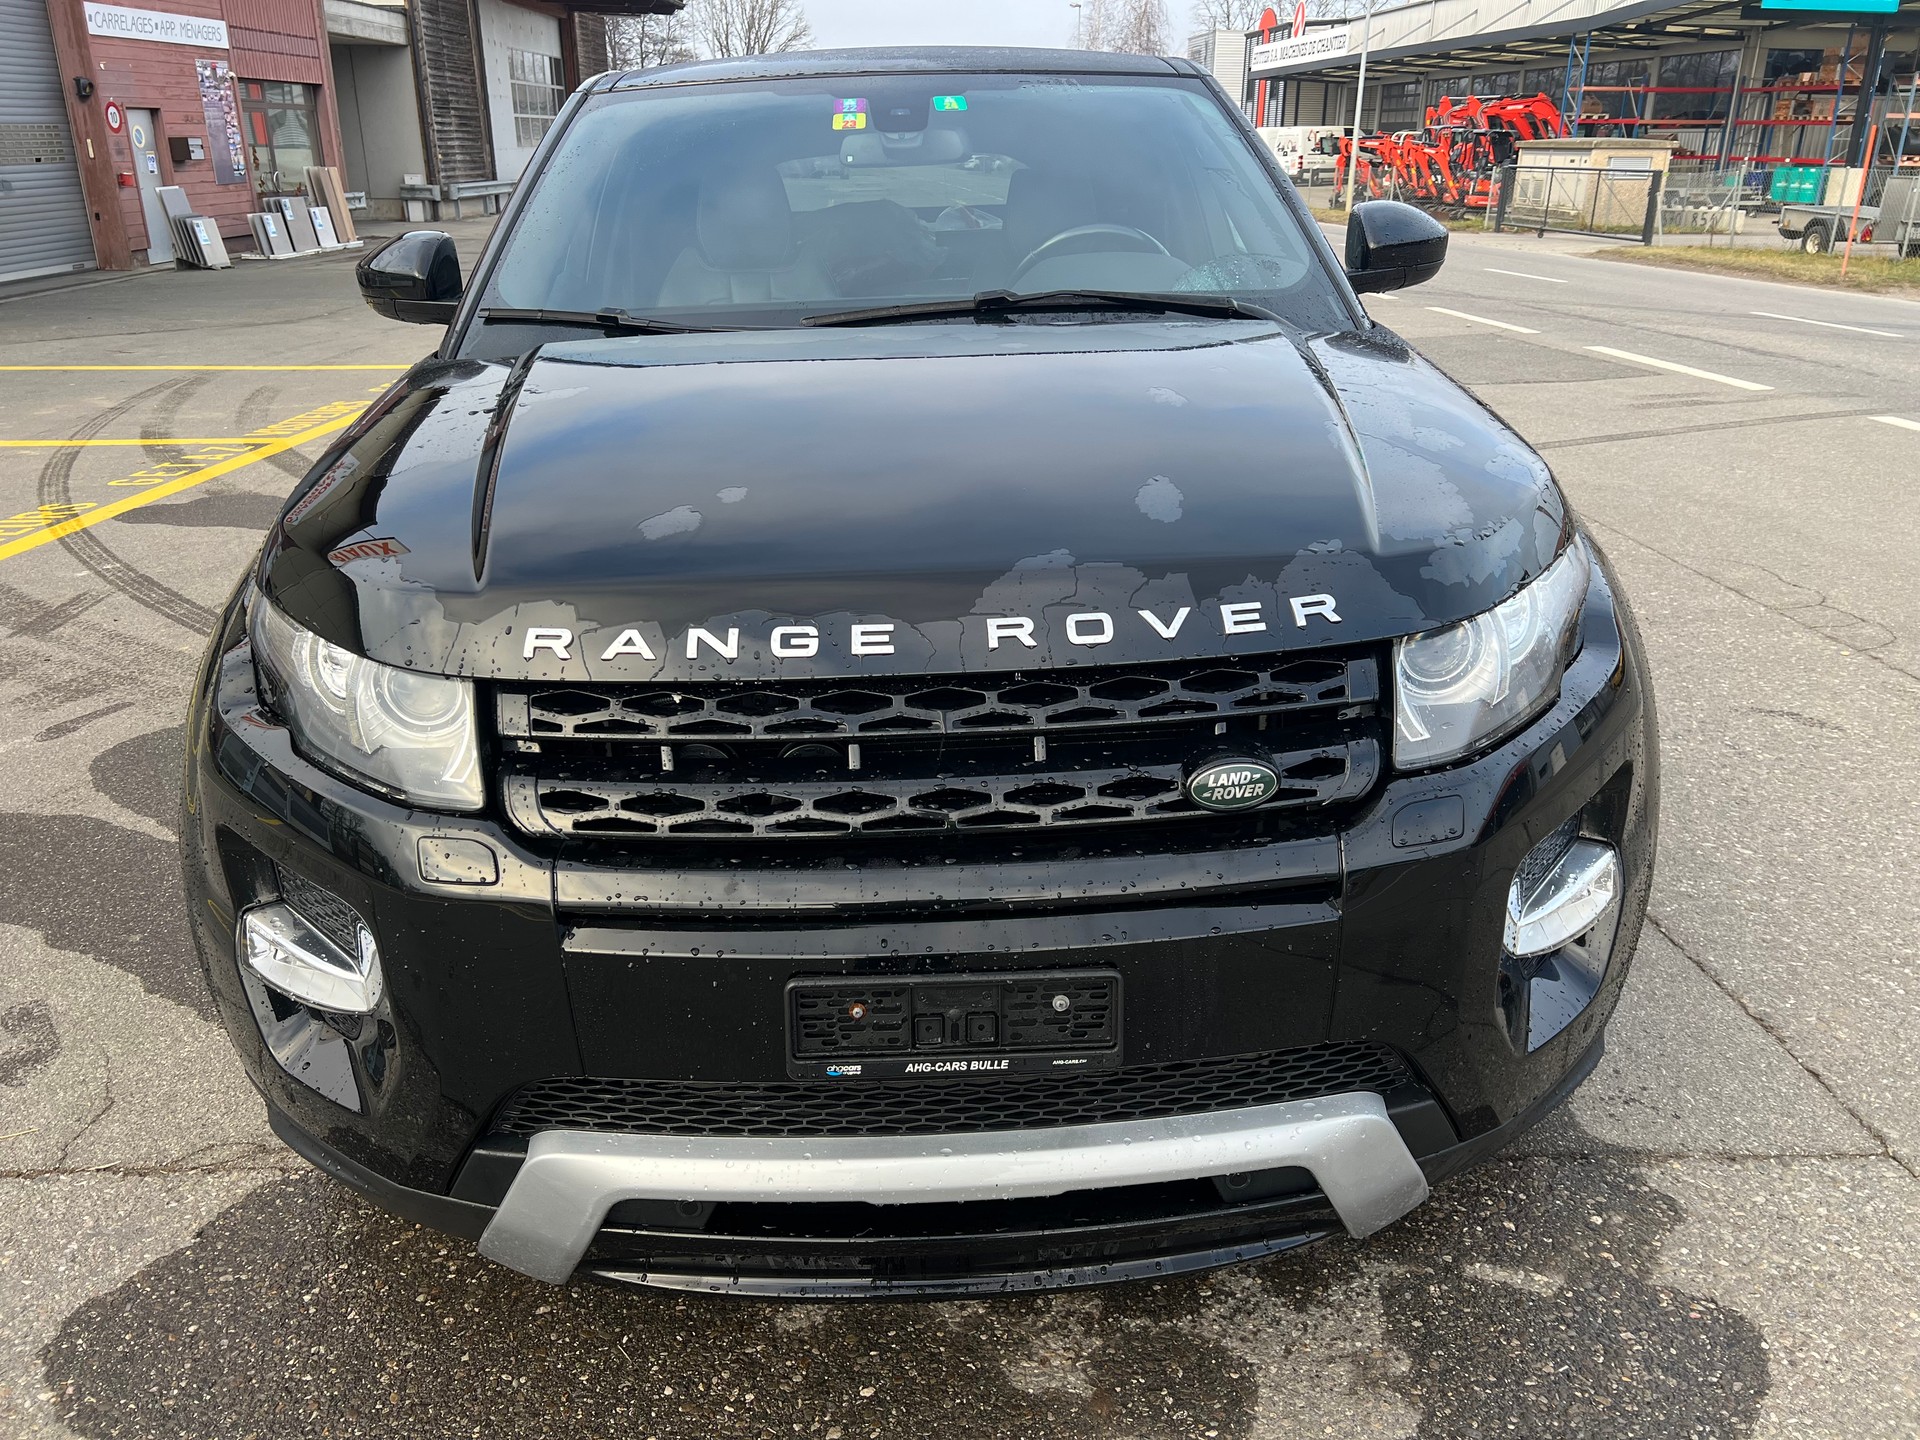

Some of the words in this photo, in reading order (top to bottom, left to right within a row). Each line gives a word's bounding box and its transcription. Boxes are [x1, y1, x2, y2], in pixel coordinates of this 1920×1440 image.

[94, 11, 153, 34] CARRELAGES
[160, 20, 178, 37] APP.
[180, 19, 222, 41] MÉNAGERS
[842, 104, 857, 112] 22
[110, 111, 118, 124] 10
[842, 120, 857, 128] 23
[107, 445, 255, 486] GETAZ
[522, 623, 895, 660] RANGE
[986, 593, 1343, 648] ROVER
[1208, 771, 1252, 787] LAND
[1211, 783, 1264, 800] ROVER
[905, 1061, 968, 1073] AHG-CARS
[970, 1060, 1009, 1070] BULLE
